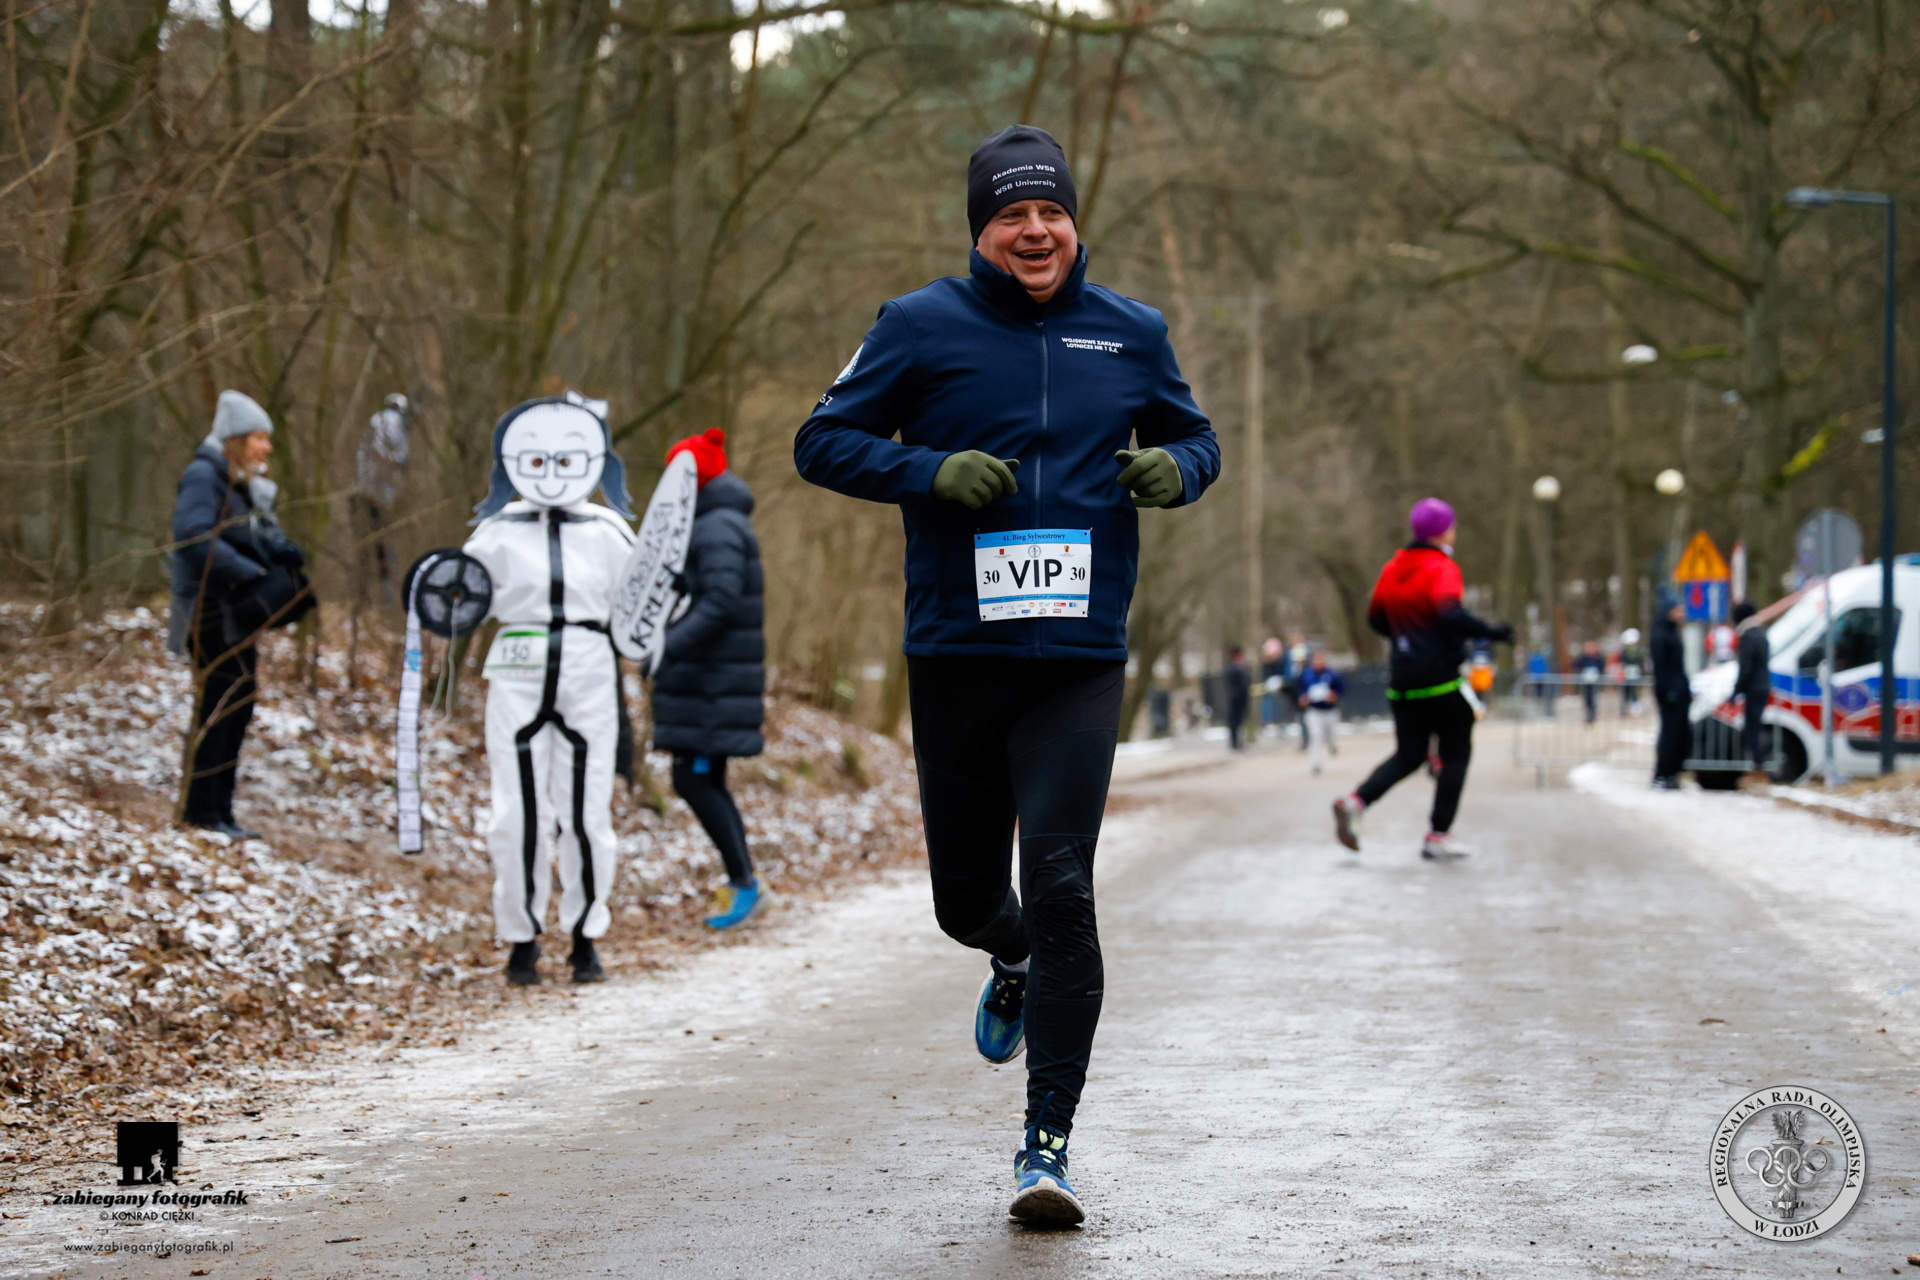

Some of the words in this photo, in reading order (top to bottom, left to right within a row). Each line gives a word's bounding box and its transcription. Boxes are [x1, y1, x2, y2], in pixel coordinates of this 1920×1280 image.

[992, 164, 1033, 181] Akademia
[1035, 164, 1055, 172] WSB
[994, 183, 1013, 196] WSB
[1015, 180, 1056, 188] University
[983, 570, 1000, 585] 30
[1008, 559, 1063, 589] VIP
[1070, 567, 1086, 581] 30
